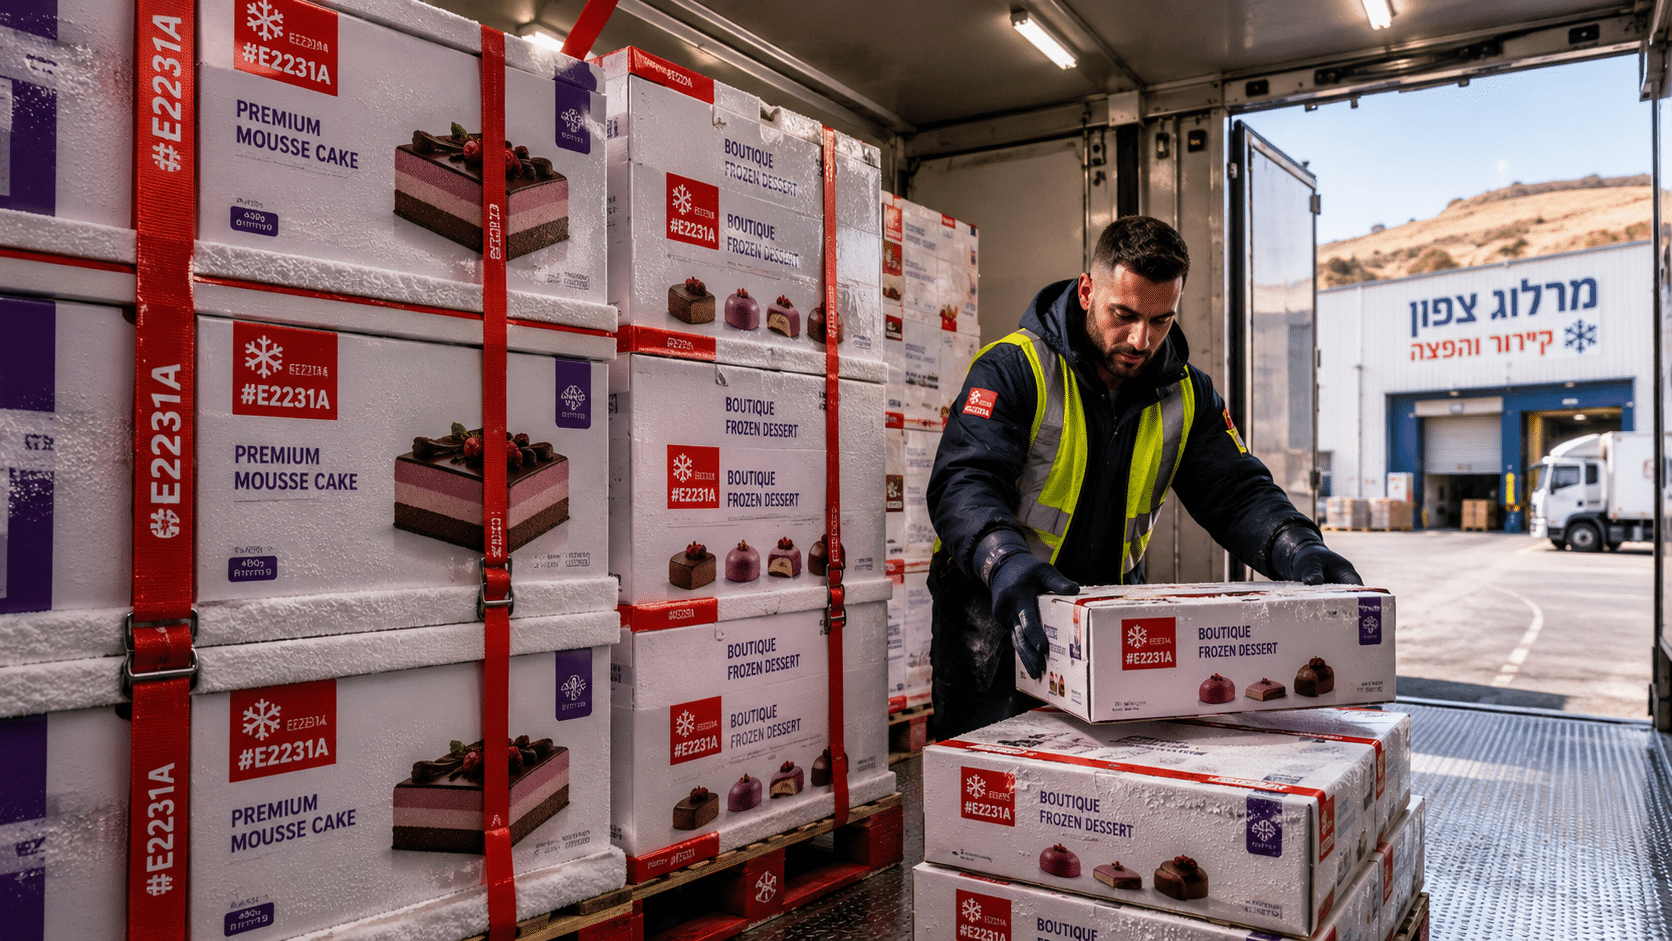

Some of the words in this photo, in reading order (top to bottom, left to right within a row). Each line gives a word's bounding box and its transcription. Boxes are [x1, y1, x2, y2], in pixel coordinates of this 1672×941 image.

[242, 42, 331, 85] #E2231A
[152, 14, 183, 172] #E2231A
[236, 99, 321, 137] PREMIUM
[236, 125, 311, 159] MOUSSE
[315, 144, 359, 170] CAKE
[725, 138, 773, 169] BOUTIQUE
[725, 161, 760, 185] FROZEN
[670, 218, 716, 243] #E2231A
[727, 213, 775, 240] BOUTIQUE
[727, 236, 762, 259] FROZEN
[1490, 277, 1598, 320] מרלוג
[1409, 292, 1478, 338] צפון
[1410, 337, 1481, 362] והפצה
[241, 383, 331, 410] #E2231A
[725, 397, 774, 416] BOUTIQUE
[725, 419, 761, 437] FROZEN
[763, 422, 799, 439] DESSERT
[235, 445, 320, 465] PREMIUM
[234, 471, 309, 491] MOUSSE
[314, 472, 358, 491] CAKE
[727, 470, 776, 488] BOUTIQUE
[671, 487, 716, 503] #E2231A
[727, 492, 762, 508] FROZEN
[764, 492, 800, 507] DESSERT
[1198, 626, 1252, 641] BOUTIQUE
[727, 638, 776, 660] BOUTIQUE
[1125, 652, 1174, 666] #E2231A
[1198, 644, 1237, 659] FROZEN
[1238, 642, 1279, 657] DESSERT
[727, 660, 763, 681] FROZEN
[765, 653, 801, 674] DESSERT
[730, 704, 778, 729] BOUTIQUE
[673, 734, 719, 758] #E2231A
[730, 730, 765, 750] FROZEN
[766, 718, 802, 741] DESSERT
[238, 737, 329, 771] #E2231A
[231, 794, 318, 828] PREMIUM
[964, 801, 1012, 821] #E2231A
[1039, 790, 1101, 813] BOUTIQUE
[146, 762, 176, 896] #E2231A
[231, 820, 307, 853] MOUSSE
[312, 809, 357, 834] CAKE
[1039, 810, 1083, 830] FROZEN
[1085, 818, 1135, 839] DESSERT
[960, 924, 1007, 941] #E2231A
[1037, 917, 1099, 941] BOUTIQUE
